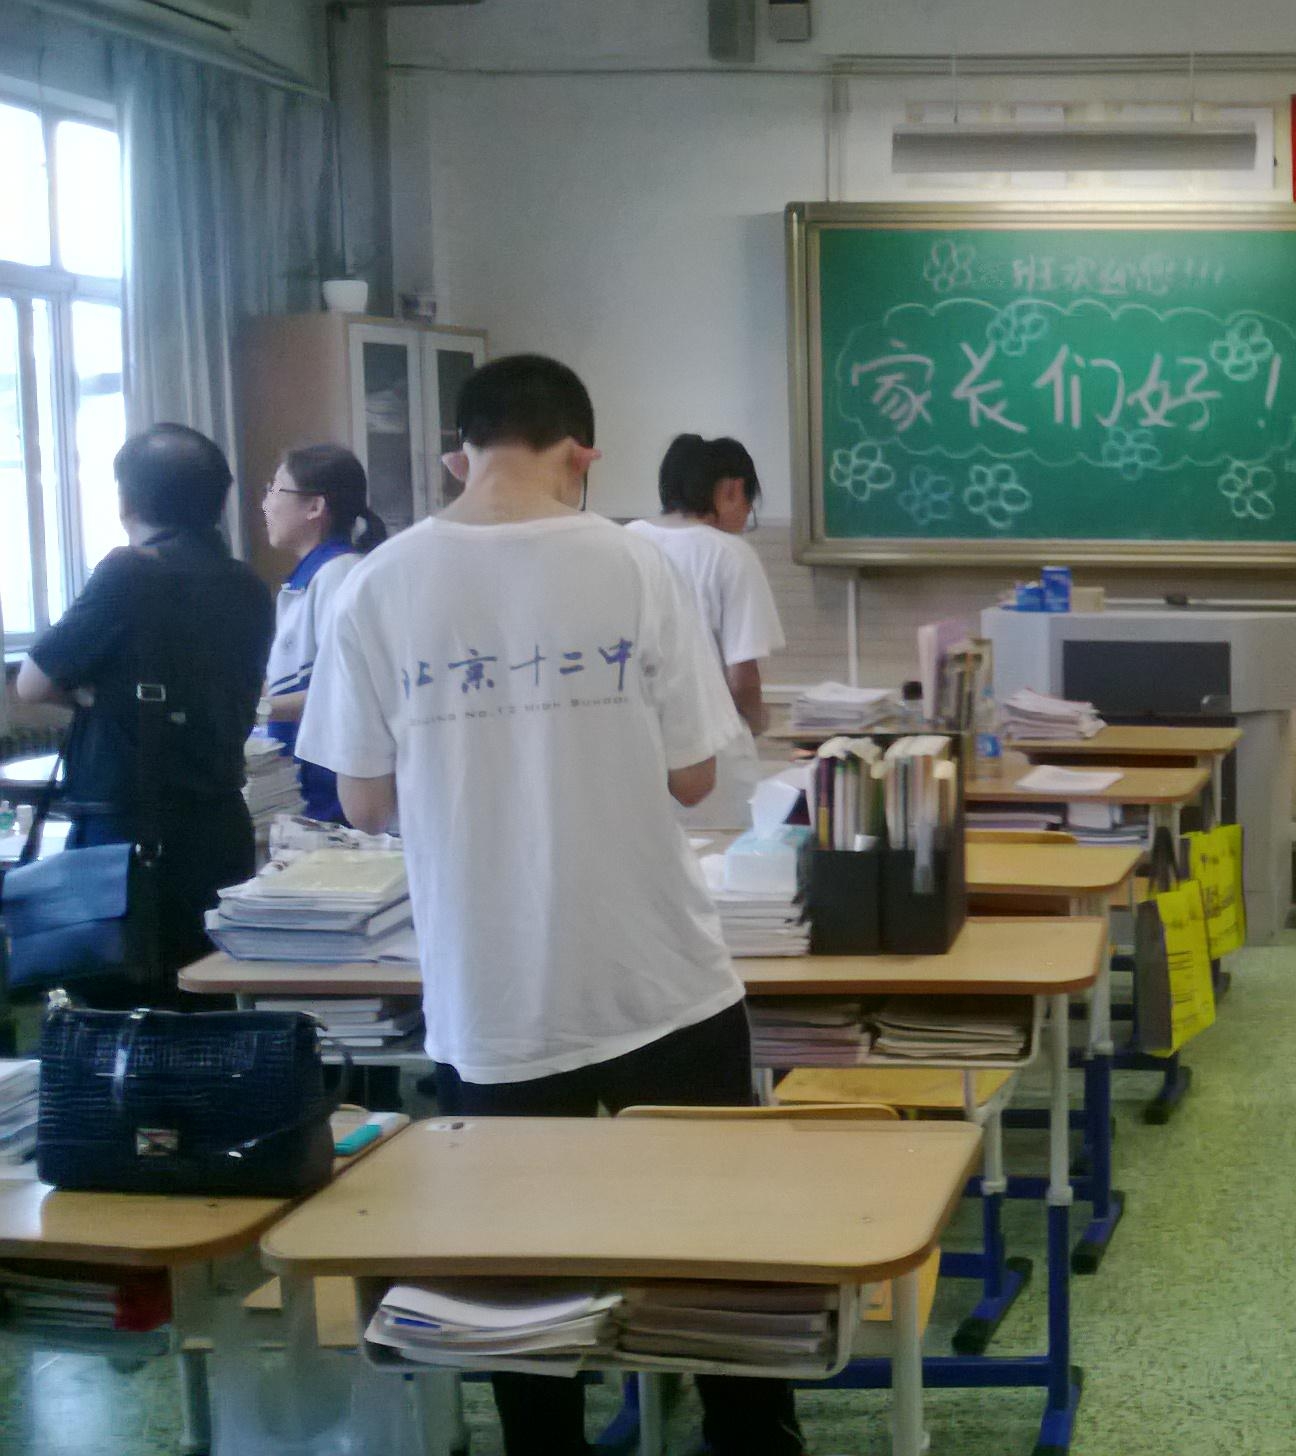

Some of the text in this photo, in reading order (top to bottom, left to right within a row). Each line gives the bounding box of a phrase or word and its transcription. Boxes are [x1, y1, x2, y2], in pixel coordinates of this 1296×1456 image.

[401, 638, 633, 699] 北京十二中
